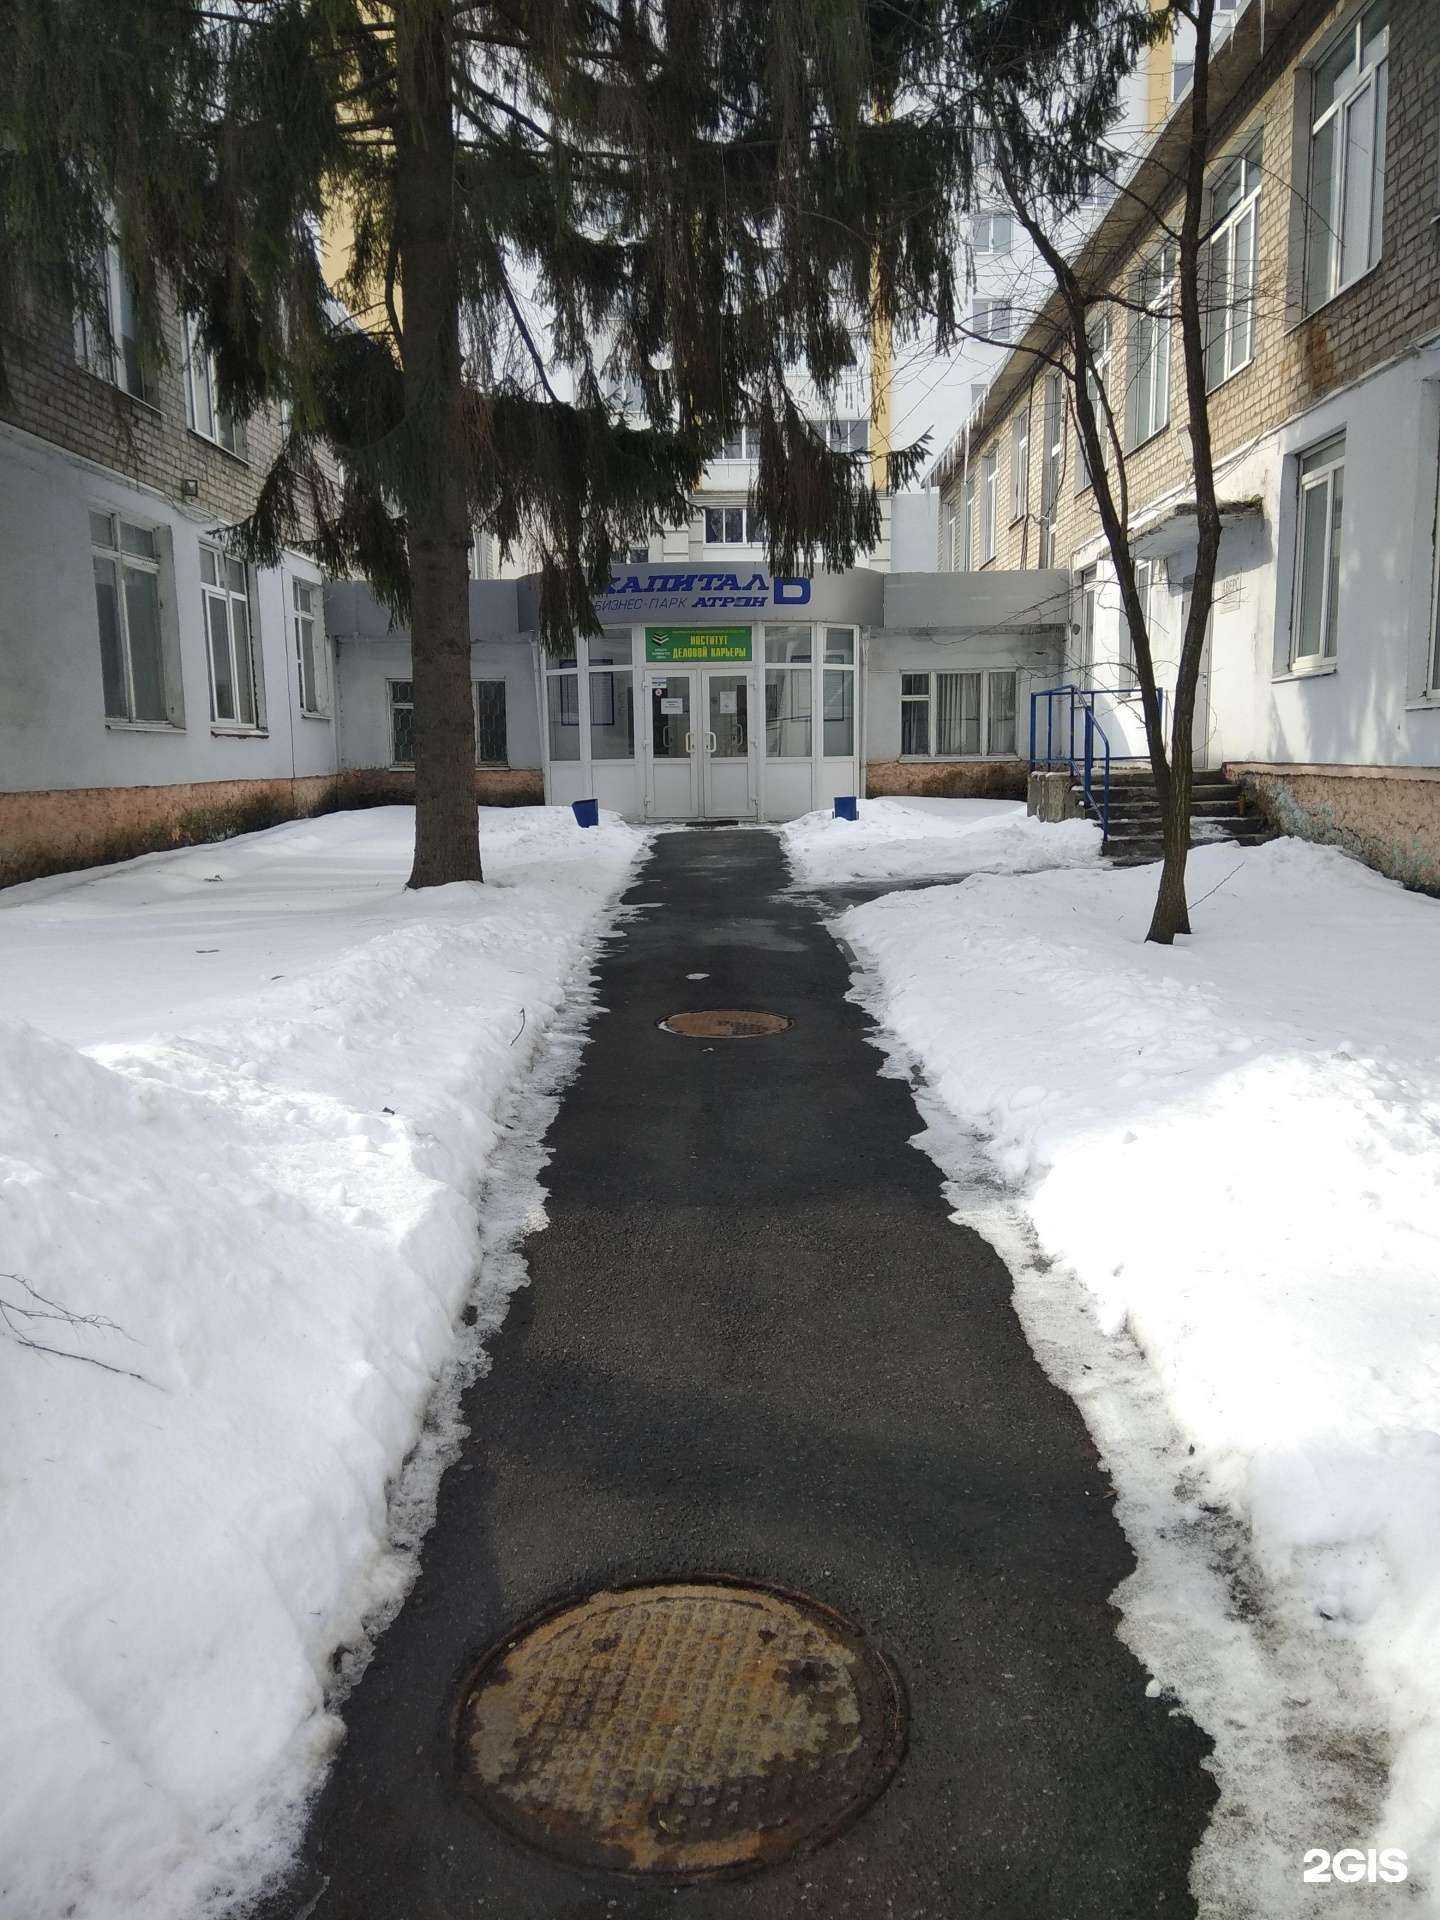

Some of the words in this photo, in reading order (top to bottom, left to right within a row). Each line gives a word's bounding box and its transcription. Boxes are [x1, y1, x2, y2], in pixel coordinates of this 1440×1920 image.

[690, 635, 729, 646] ИНСТИТУТ
[673, 646, 708, 659] ДЕЛОВОЙ
[711, 647, 746, 657] КАРЬЕРЫ
